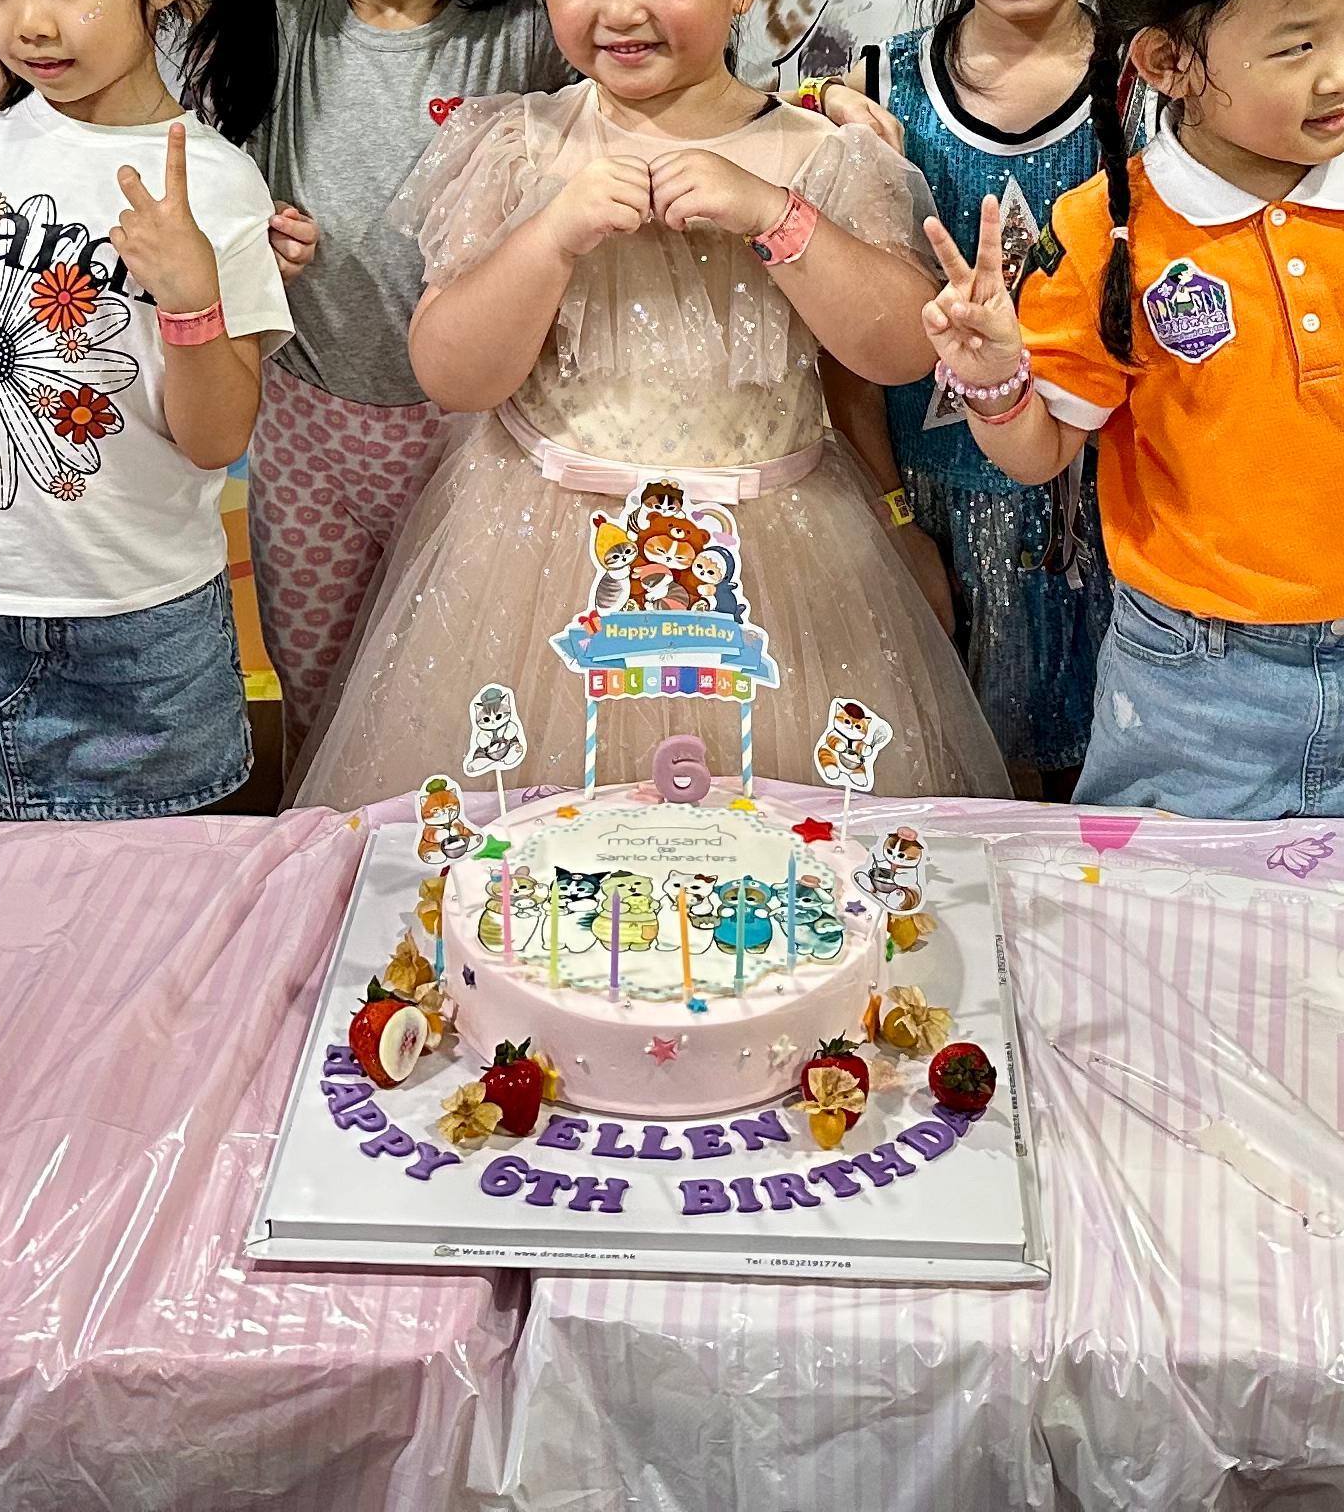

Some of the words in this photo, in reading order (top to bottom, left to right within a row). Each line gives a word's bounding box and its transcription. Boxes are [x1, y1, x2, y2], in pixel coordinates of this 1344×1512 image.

[606, 623, 657, 640] Happy
[661, 622, 735, 642] Birthday
[592, 674, 677, 690] Ellen
[607, 836, 722, 846] mofusand
[650, 853, 737, 862] characters
[320, 1044, 463, 1180] HAPPY
[480, 1155, 630, 1213] 6TH
[679, 1102, 987, 1215] BIRTHDA
[536, 1109, 791, 1160] ELLEN
[462, 1248, 505, 1256] Website
